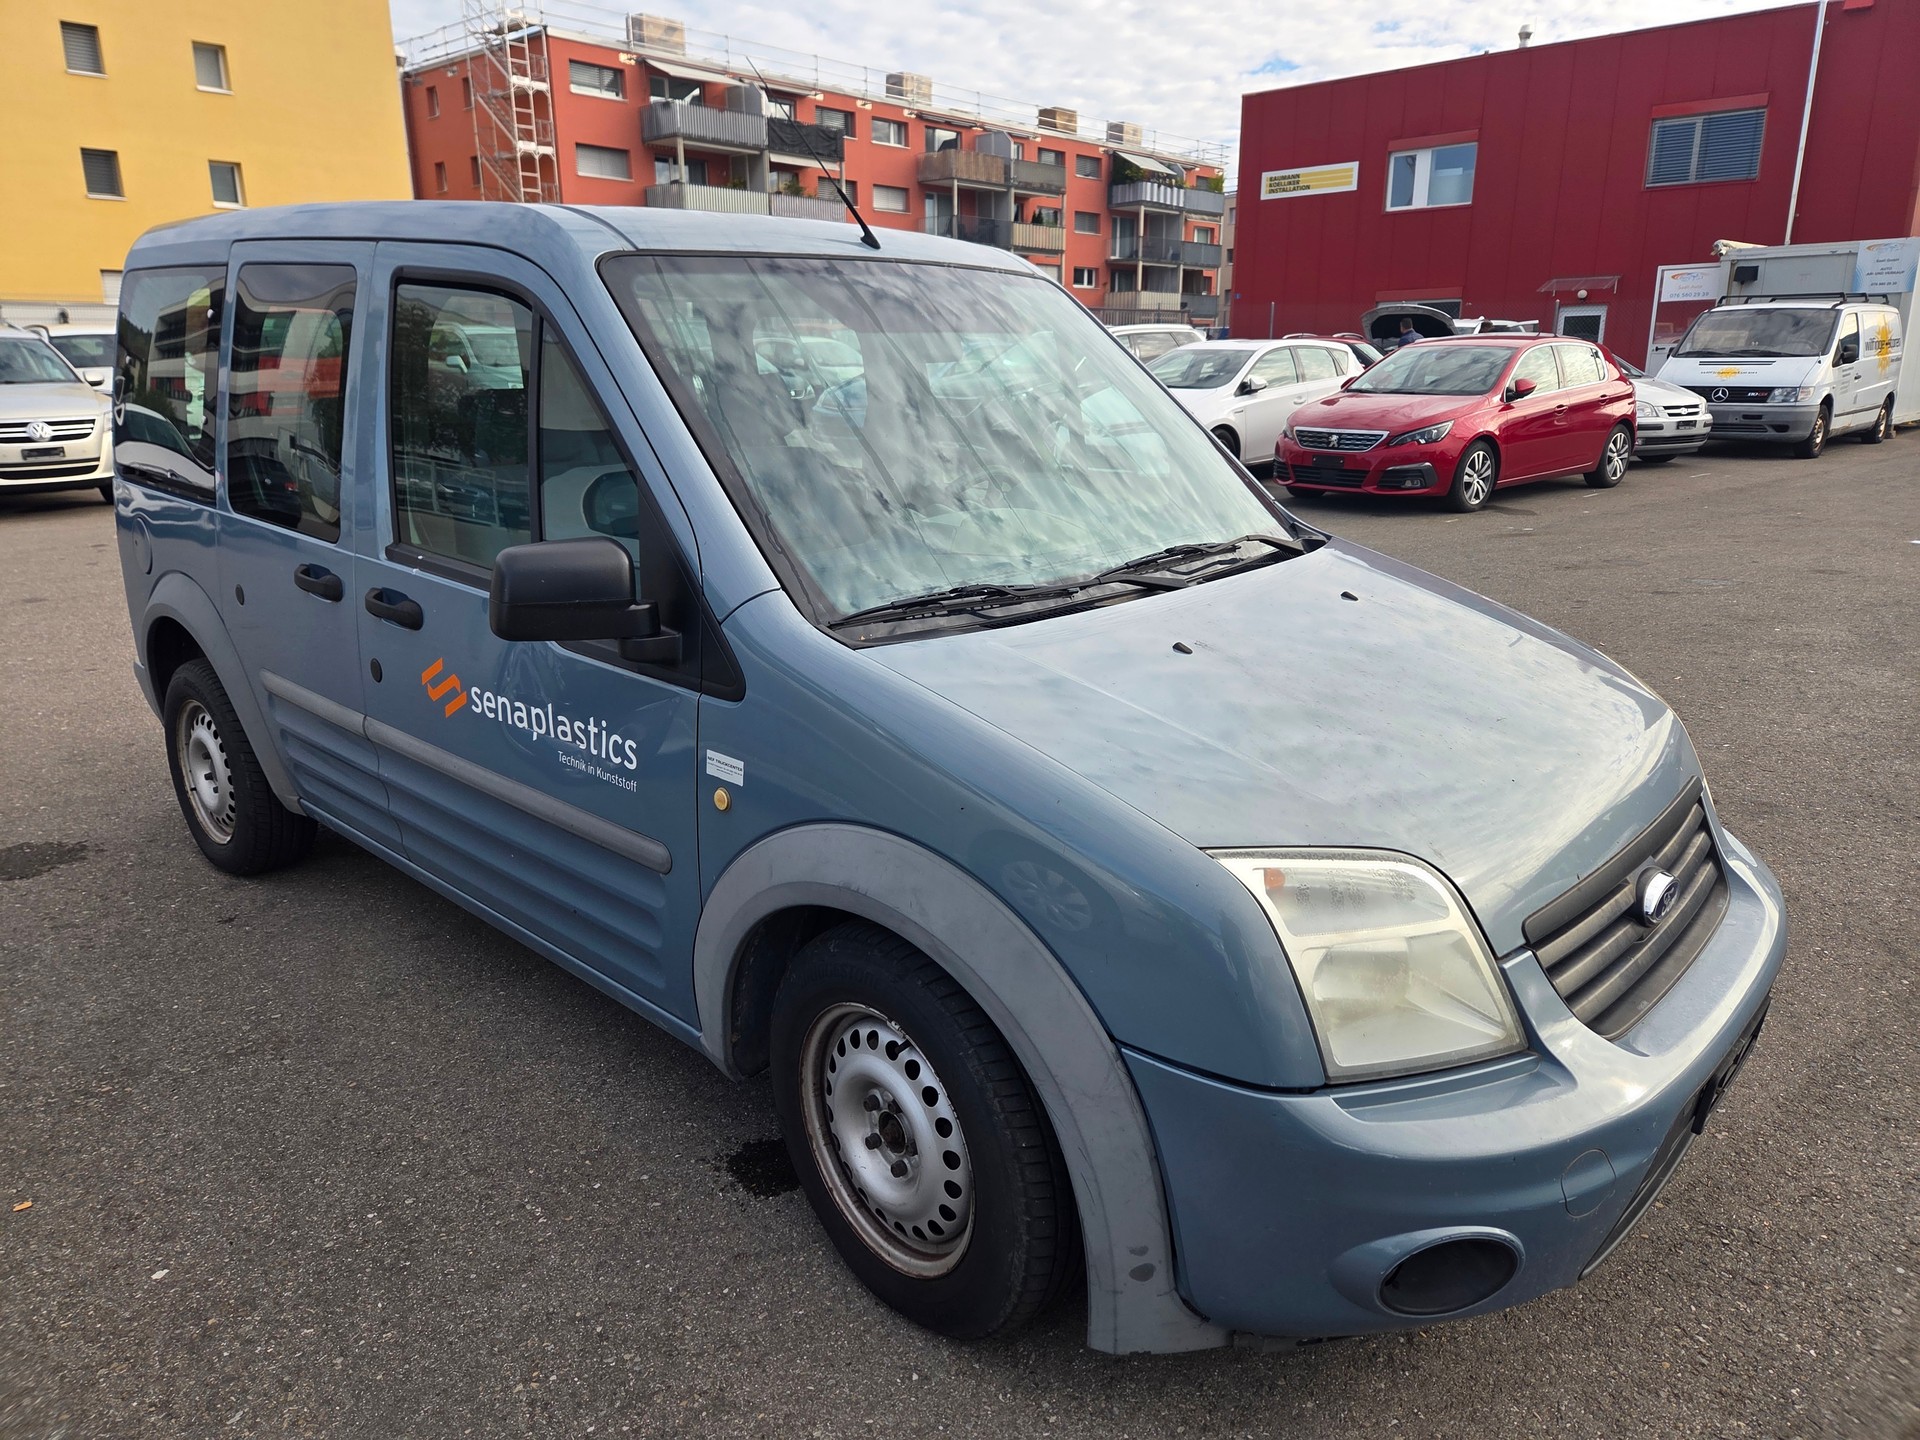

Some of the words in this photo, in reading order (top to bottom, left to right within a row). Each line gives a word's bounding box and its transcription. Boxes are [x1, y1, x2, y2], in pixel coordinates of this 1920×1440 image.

[1268, 185, 1311, 194] INSTALLATION
[471, 686, 637, 770] senaplastics
[557, 751, 587, 772] Technik
[587, 762, 595, 775] in
[596, 766, 637, 793] Kunststoff
